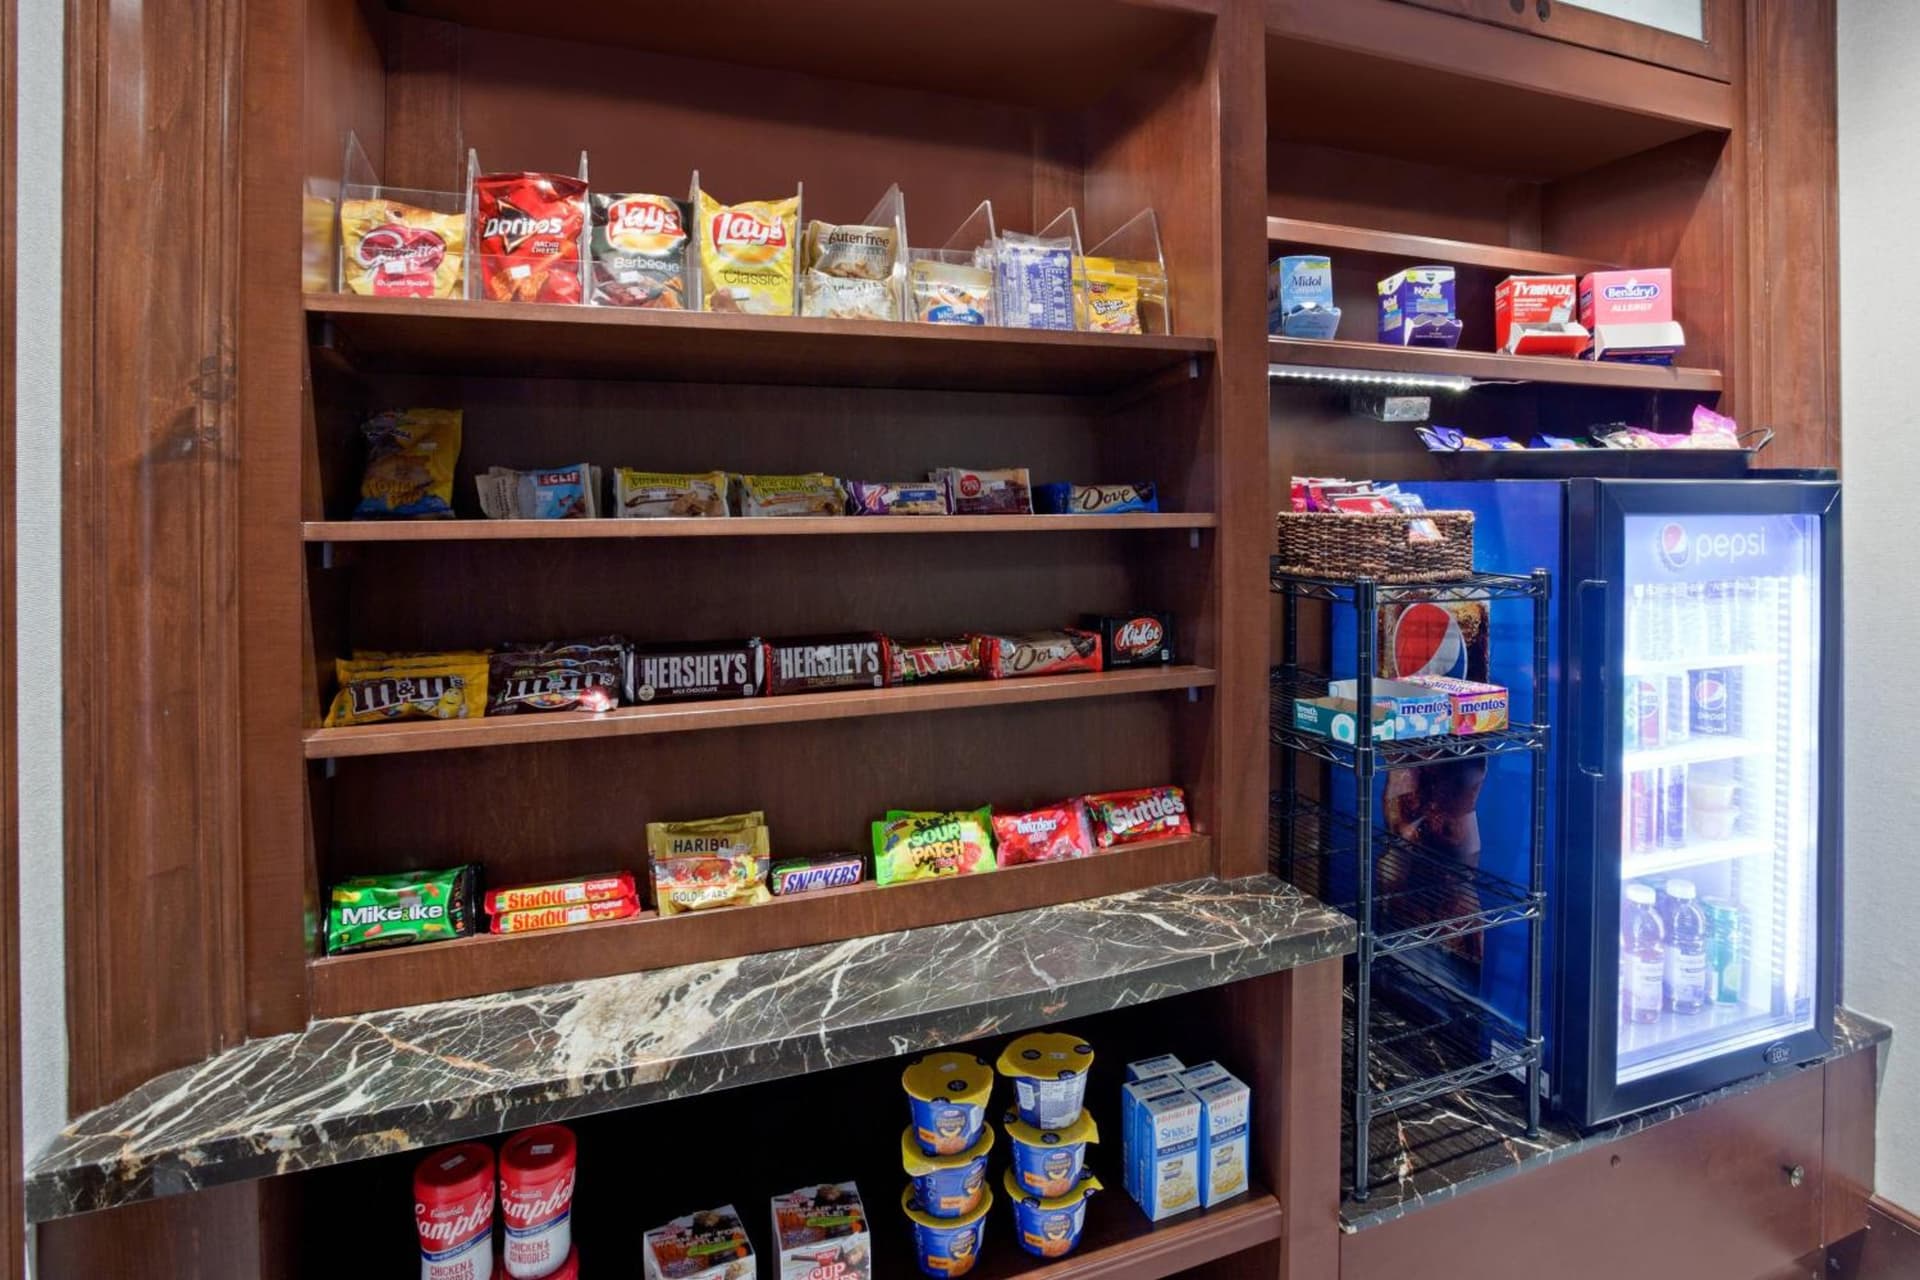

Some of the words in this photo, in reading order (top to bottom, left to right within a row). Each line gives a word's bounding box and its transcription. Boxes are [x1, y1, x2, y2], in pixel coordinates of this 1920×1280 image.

[484, 217, 564, 238] Doritos
[612, 202, 679, 236] Lay's
[718, 212, 783, 246] Lay's
[866, 229, 890, 246] free
[723, 270, 781, 286] Classic
[1291, 275, 1322, 287] Midol
[1608, 286, 1654, 299] Benadryl
[550, 471, 580, 483] CLIF
[1080, 486, 1132, 510] Dove
[1695, 526, 1767, 563] pepsi
[643, 653, 747, 689] HERSHEY'S
[780, 642, 879, 680] HERSHEY'S
[1401, 701, 1450, 715] mentos
[1461, 700, 1506, 713] mentos
[1110, 796, 1185, 834] Skittles
[911, 823, 961, 846] SOUR
[674, 838, 729, 854] HARIBO
[911, 841, 965, 864] PATCH
[786, 864, 859, 893] SNICKERS
[341, 906, 402, 925] Mike
[409, 904, 443, 920] Ike
[430, 1261, 468, 1277] CHICKEN
[809, 1261, 847, 1280] CUP
